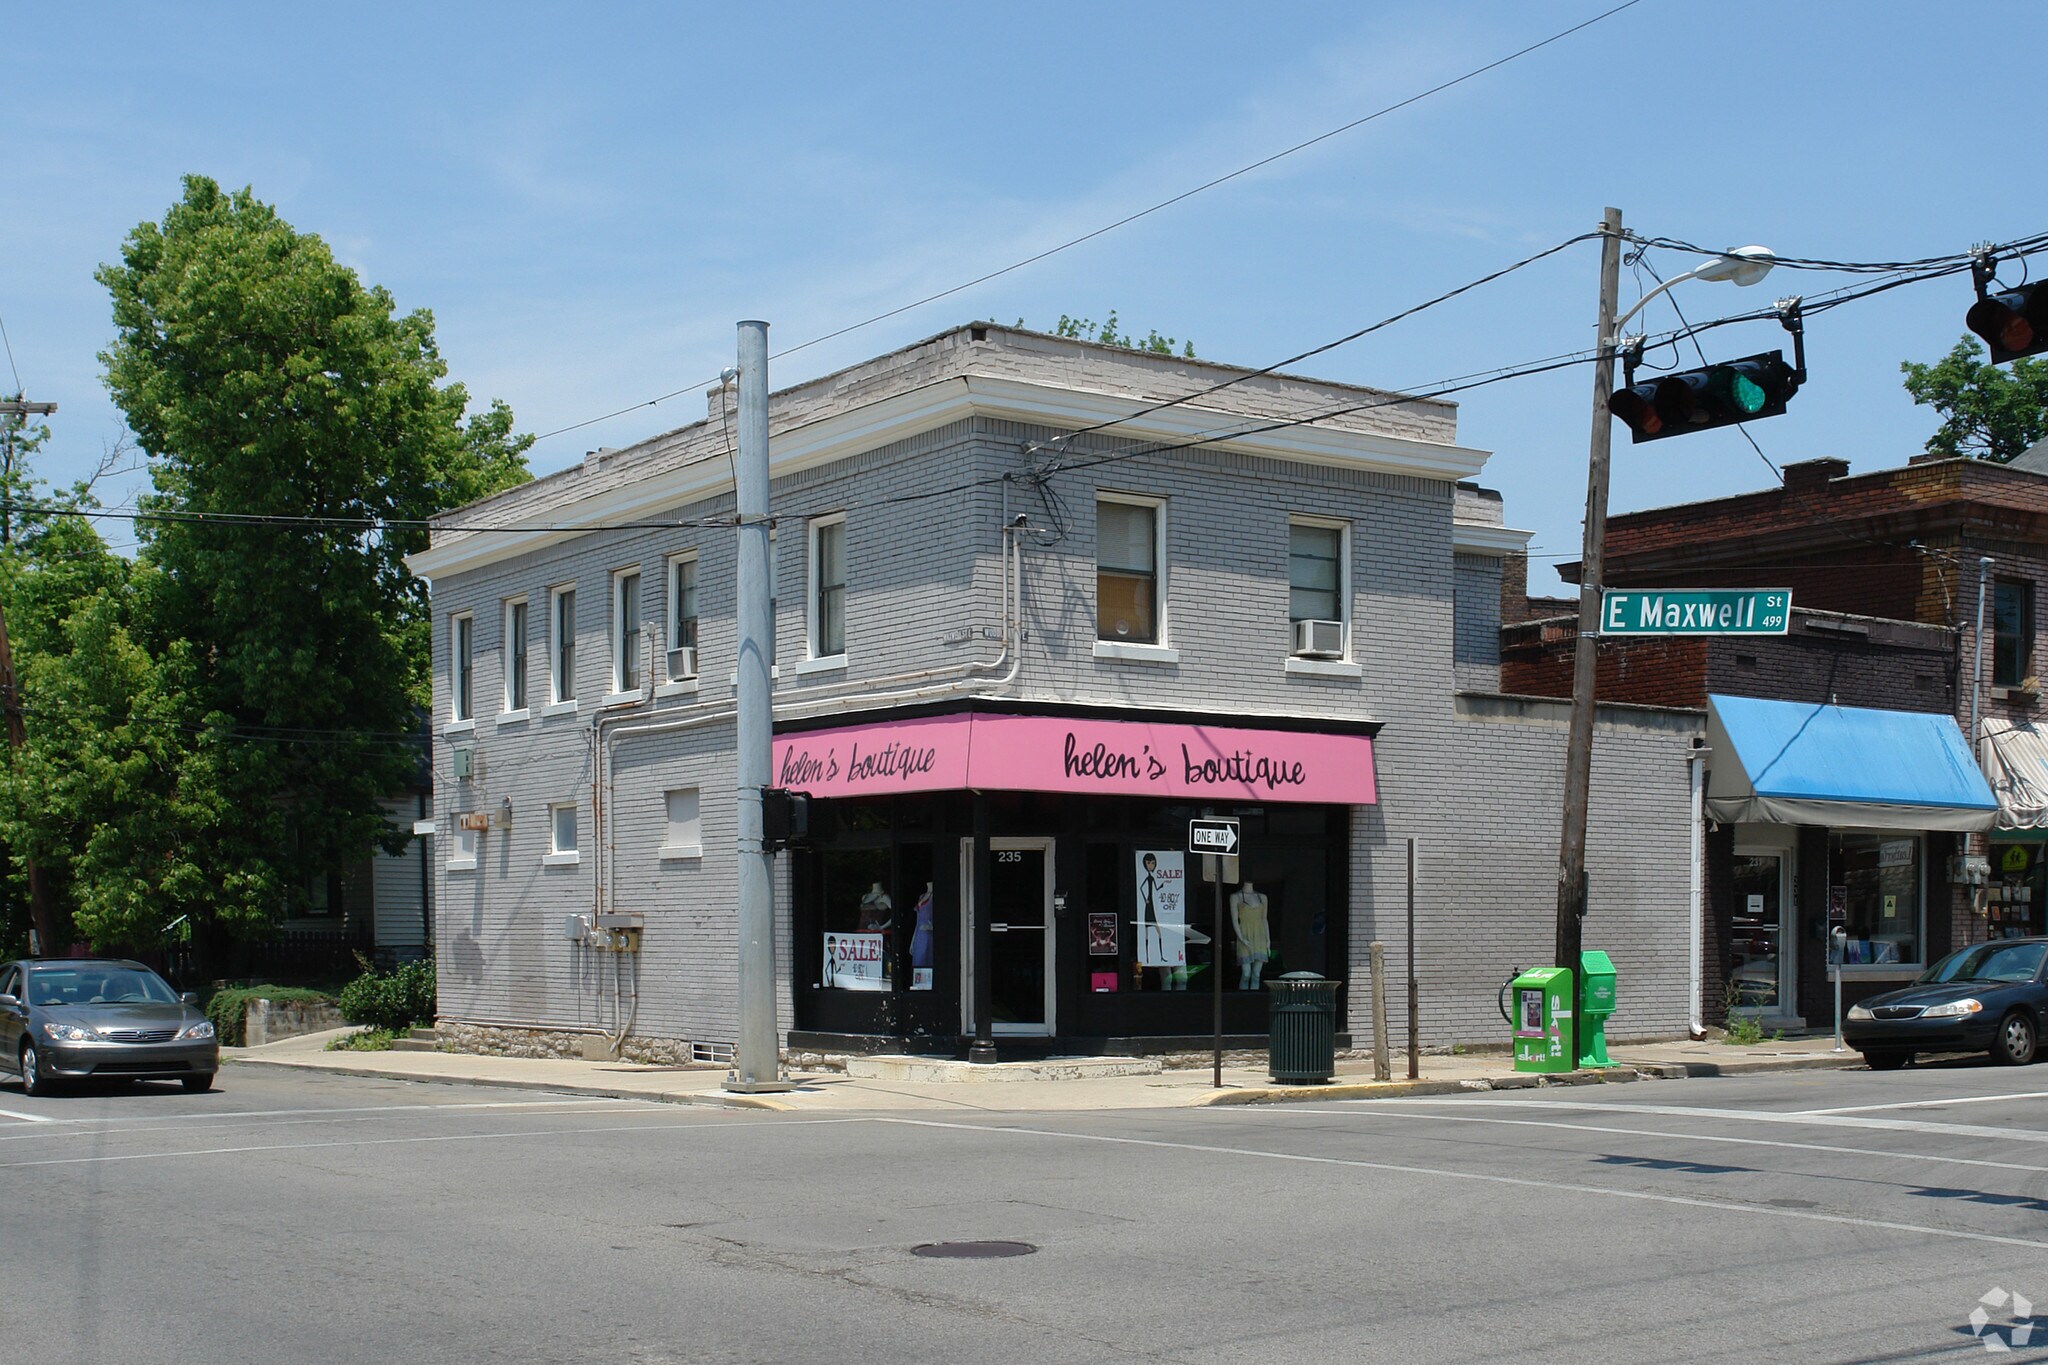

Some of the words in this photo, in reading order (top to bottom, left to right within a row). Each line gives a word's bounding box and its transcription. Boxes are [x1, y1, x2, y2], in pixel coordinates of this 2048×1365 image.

[1766, 596, 1782, 608] St
[1609, 596, 1628, 628] E
[1639, 596, 1756, 628] Maxwell
[1762, 616, 1782, 627] 499
[779, 744, 840, 788] helen's
[847, 742, 935, 781] boutique
[1064, 732, 1167, 781] helen's
[1181, 743, 1306, 790] boutique
[1196, 830, 1212, 843] ONE
[1214, 831, 1229, 845] WAY
[998, 851, 1022, 863] 235
[1156, 869, 1183, 879] SALE!
[838, 939, 882, 962] SALE!
